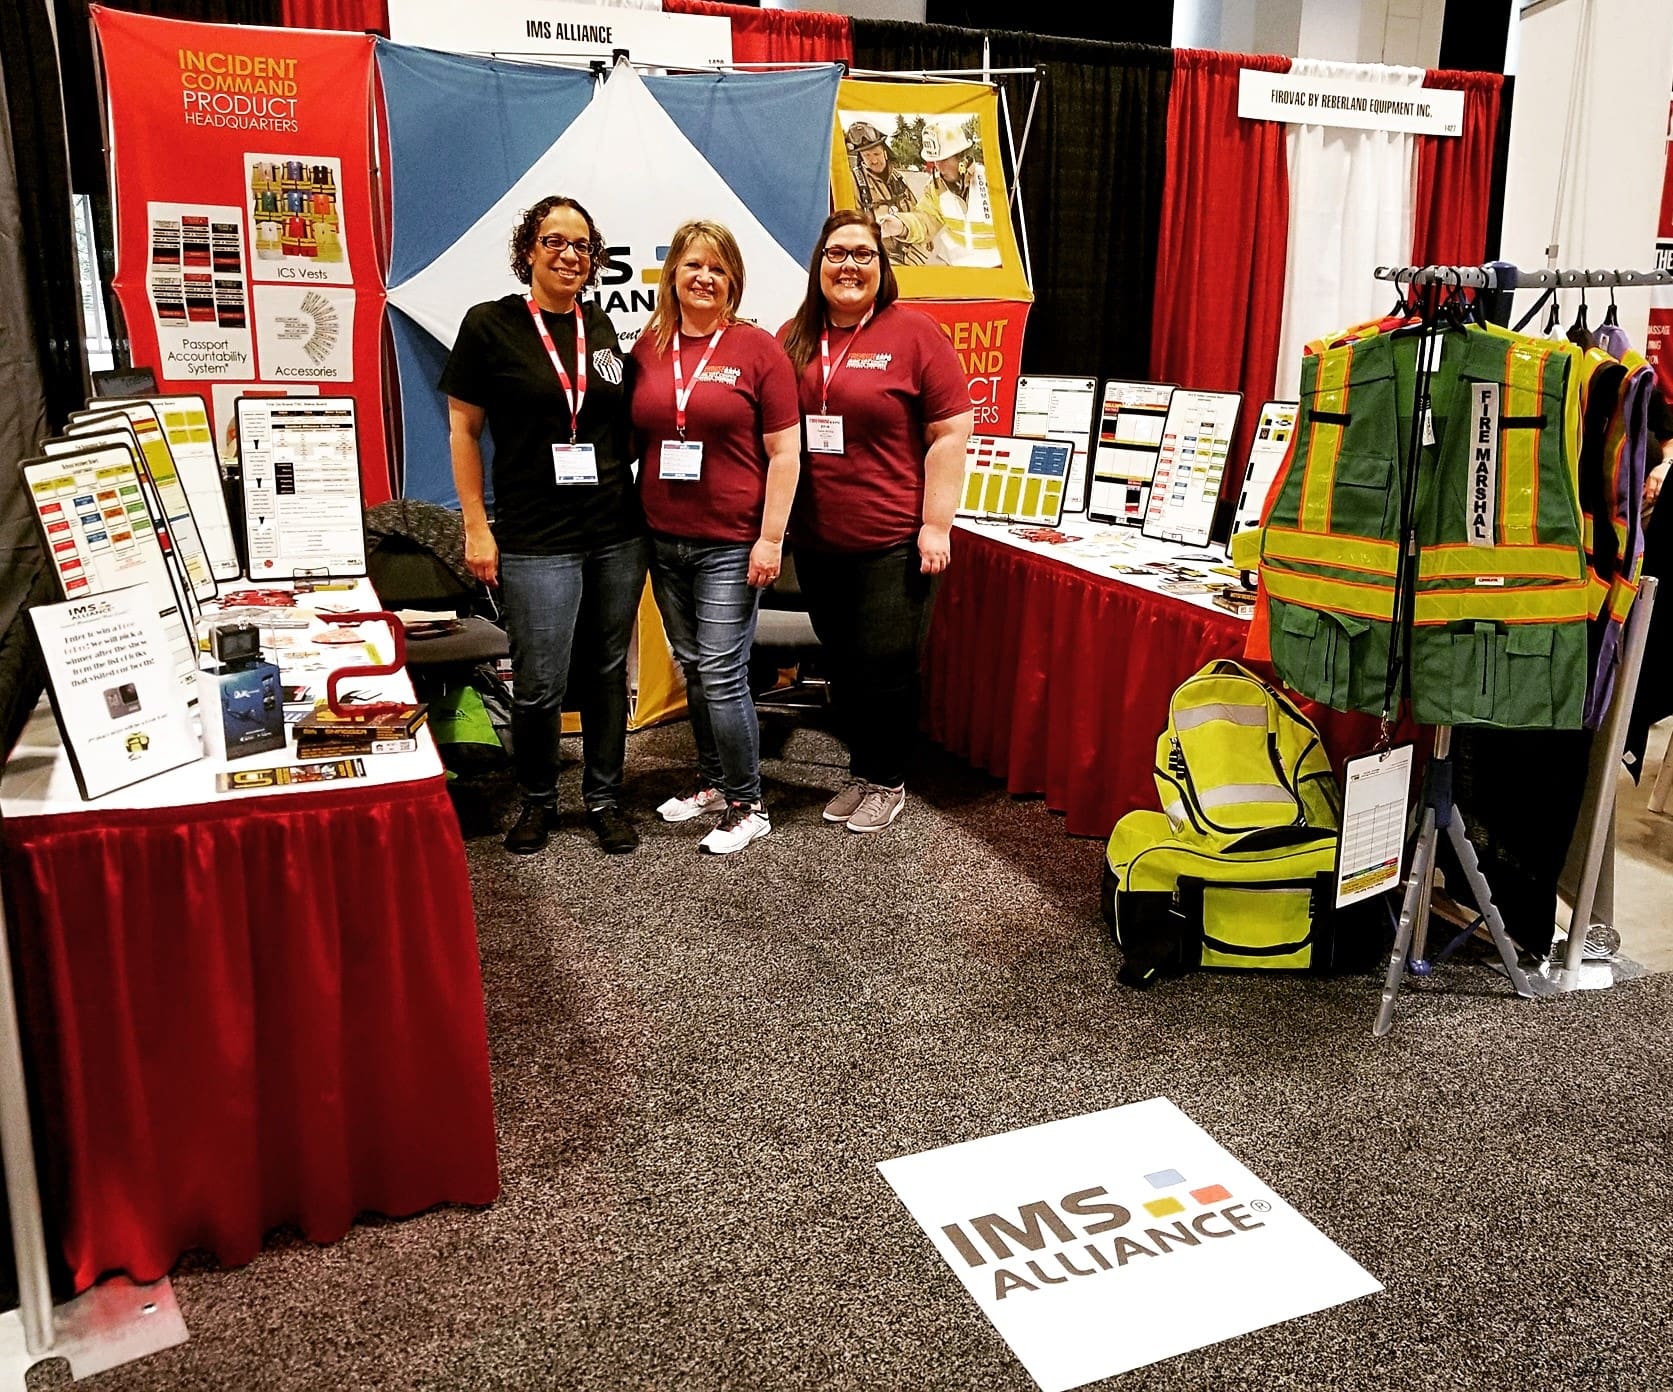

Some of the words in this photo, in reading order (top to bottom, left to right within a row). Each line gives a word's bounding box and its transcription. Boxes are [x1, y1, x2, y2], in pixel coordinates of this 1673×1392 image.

[526, 20, 551, 39] IMS
[556, 22, 613, 44] ALLIANCE
[178, 49, 298, 79] INCIDENT
[181, 72, 298, 96] COMMAND
[183, 90, 298, 118] PRODUCT
[1271, 89, 1306, 106] FIROVAC
[1308, 91, 1320, 108] BY
[1321, 93, 1367, 112] REBERLAND
[1369, 98, 1415, 117] EQUIPMENT
[1416, 103, 1433, 118] INC.
[184, 111, 299, 133] HEADQUARTERS
[277, 267, 296, 278] ICS
[298, 268, 328, 280] Vests
[167, 351, 247, 363] Accountability
[182, 338, 229, 352] Passport
[275, 366, 337, 377] Accessories
[1478, 390, 1492, 444] FIRE
[1472, 447, 1490, 539] MARSHAL
[68, 603, 97, 616] IMS
[941, 1185, 1131, 1269] IMS
